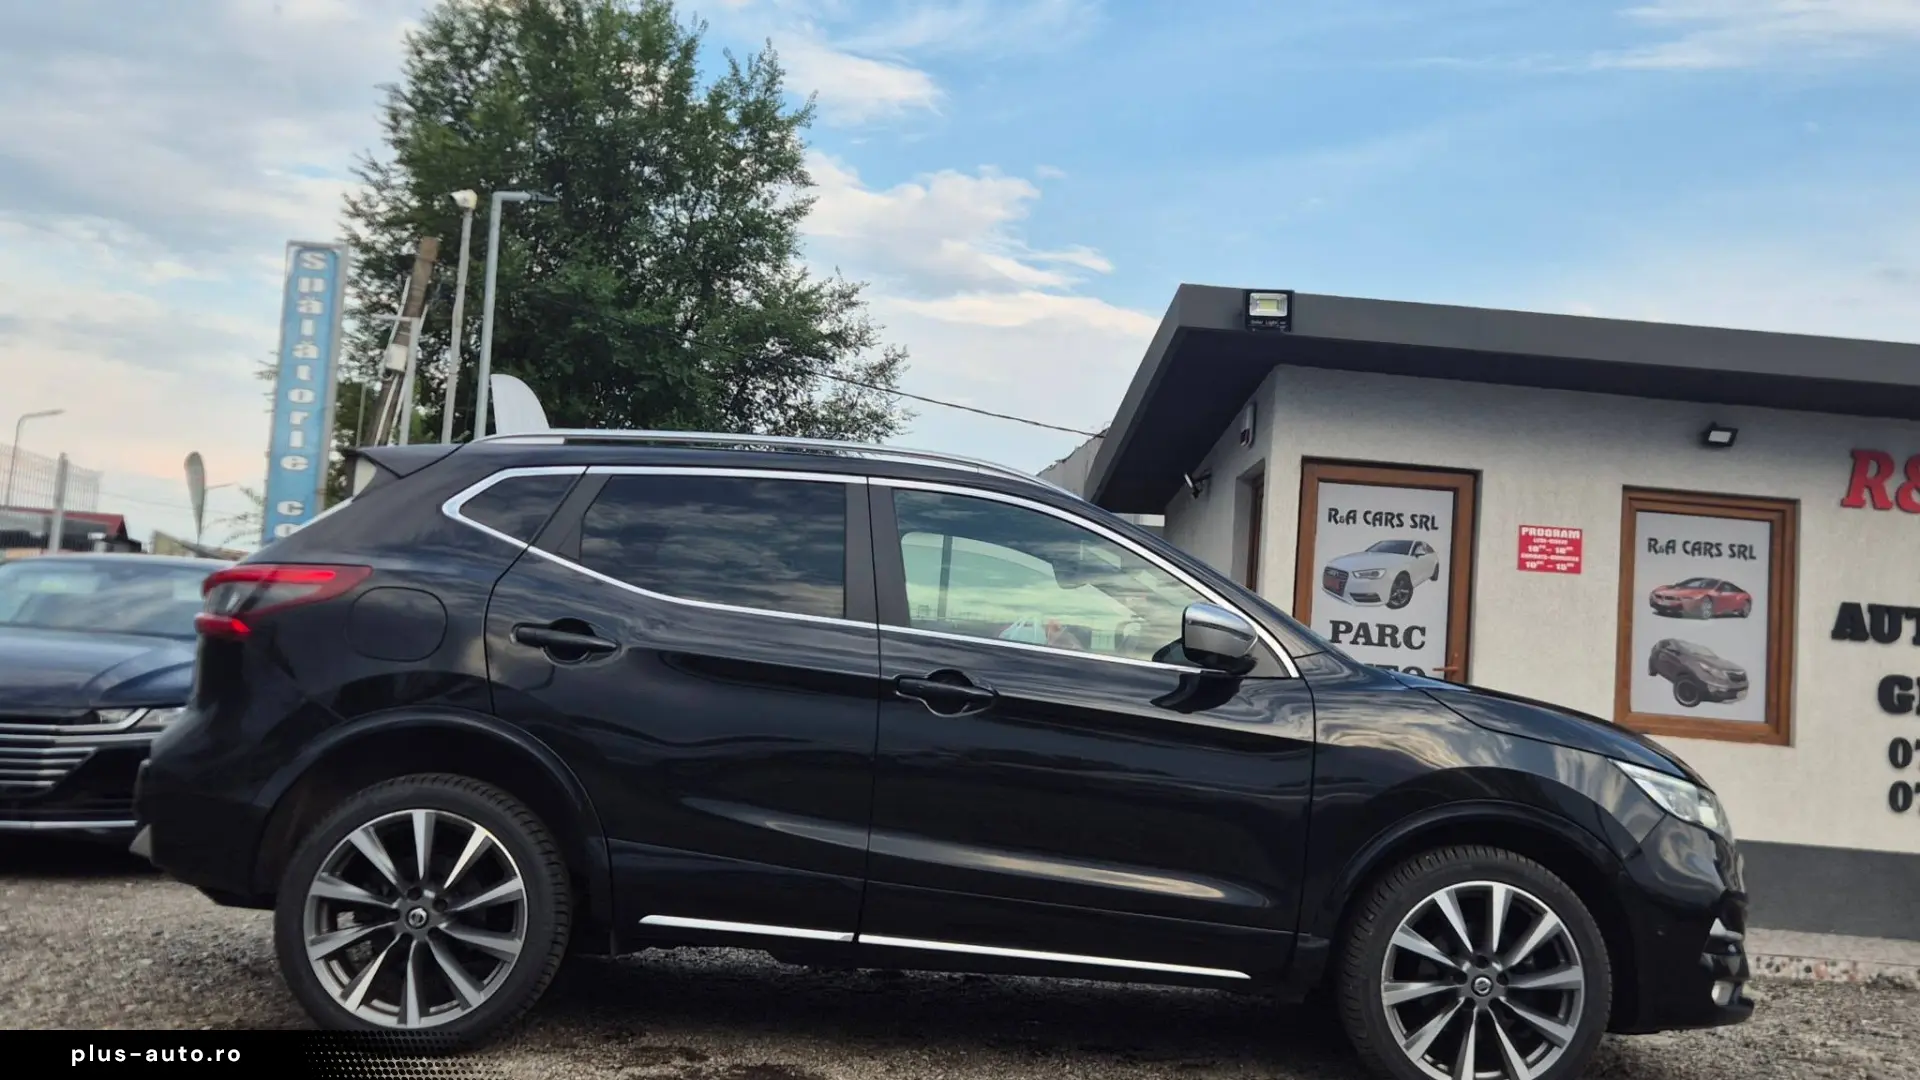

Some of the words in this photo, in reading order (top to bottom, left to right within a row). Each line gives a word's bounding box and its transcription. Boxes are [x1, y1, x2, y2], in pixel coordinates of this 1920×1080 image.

[1327, 507, 1357, 525] R&A
[1363, 510, 1405, 529] CARS
[1409, 514, 1439, 531] SRL
[1521, 527, 1580, 539] PROGRAM
[1647, 537, 1676, 555] R&A
[1682, 540, 1722, 559] CARS
[1728, 543, 1756, 561] SRL
[1329, 620, 1426, 650] PARC
[1877, 674, 1920, 715] G
[1888, 737, 1920, 769] 0
[1888, 780, 1920, 813] 0
